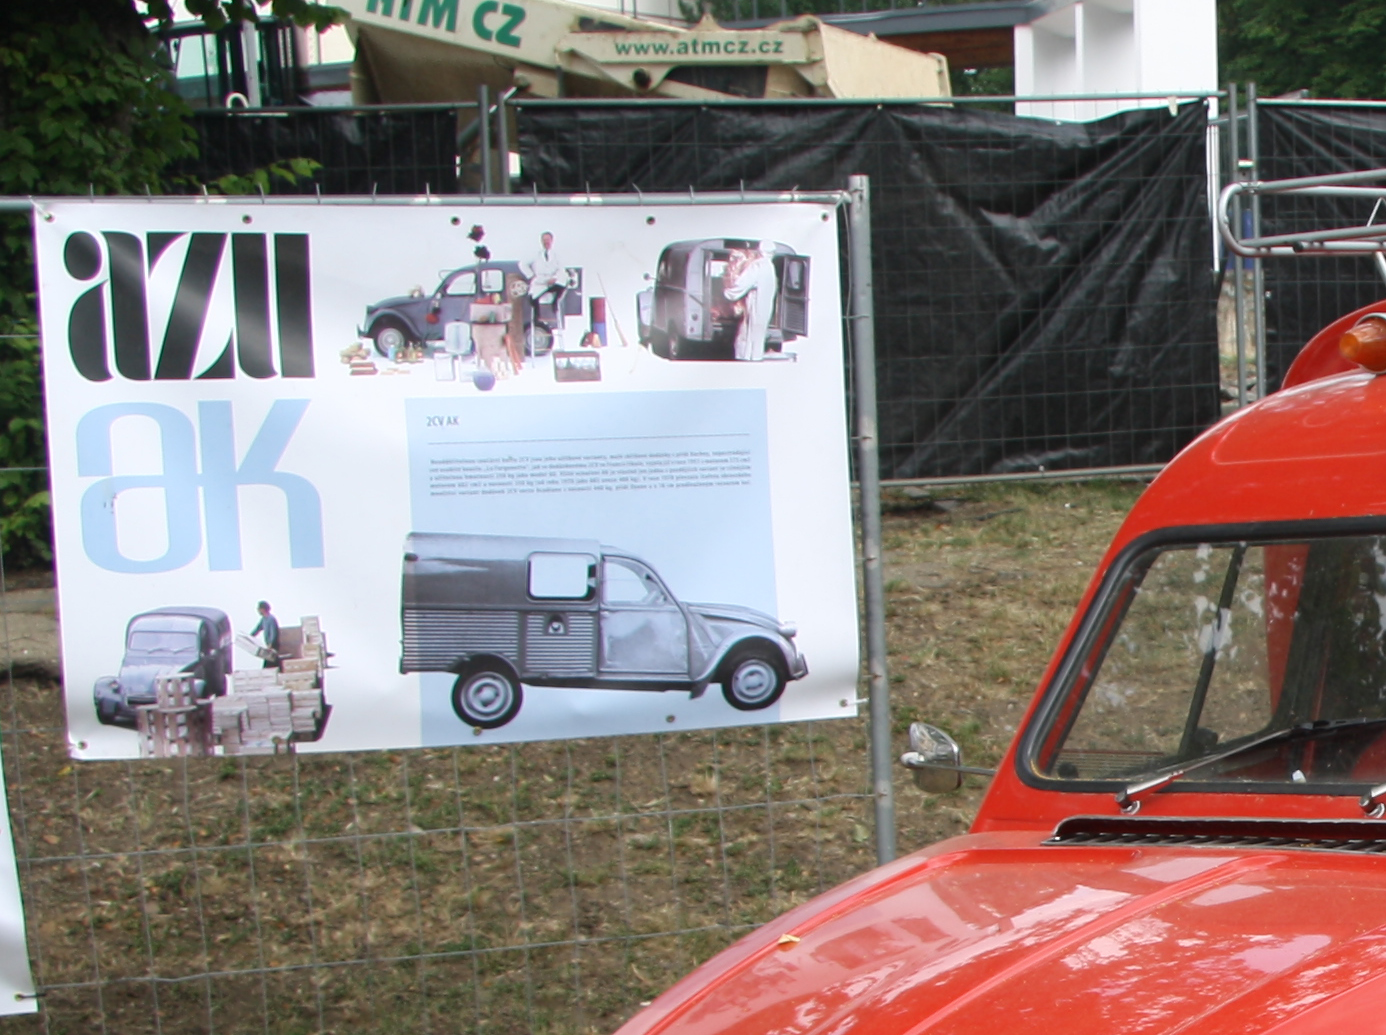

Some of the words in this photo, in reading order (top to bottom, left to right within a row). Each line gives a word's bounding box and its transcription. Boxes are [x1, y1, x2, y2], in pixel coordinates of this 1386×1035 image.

[472, 0, 526, 48] CZ
[614, 38, 784, 55] www.atmcz.cz
[426, 416, 443, 427] 2CV
[446, 415, 459, 426] AK
